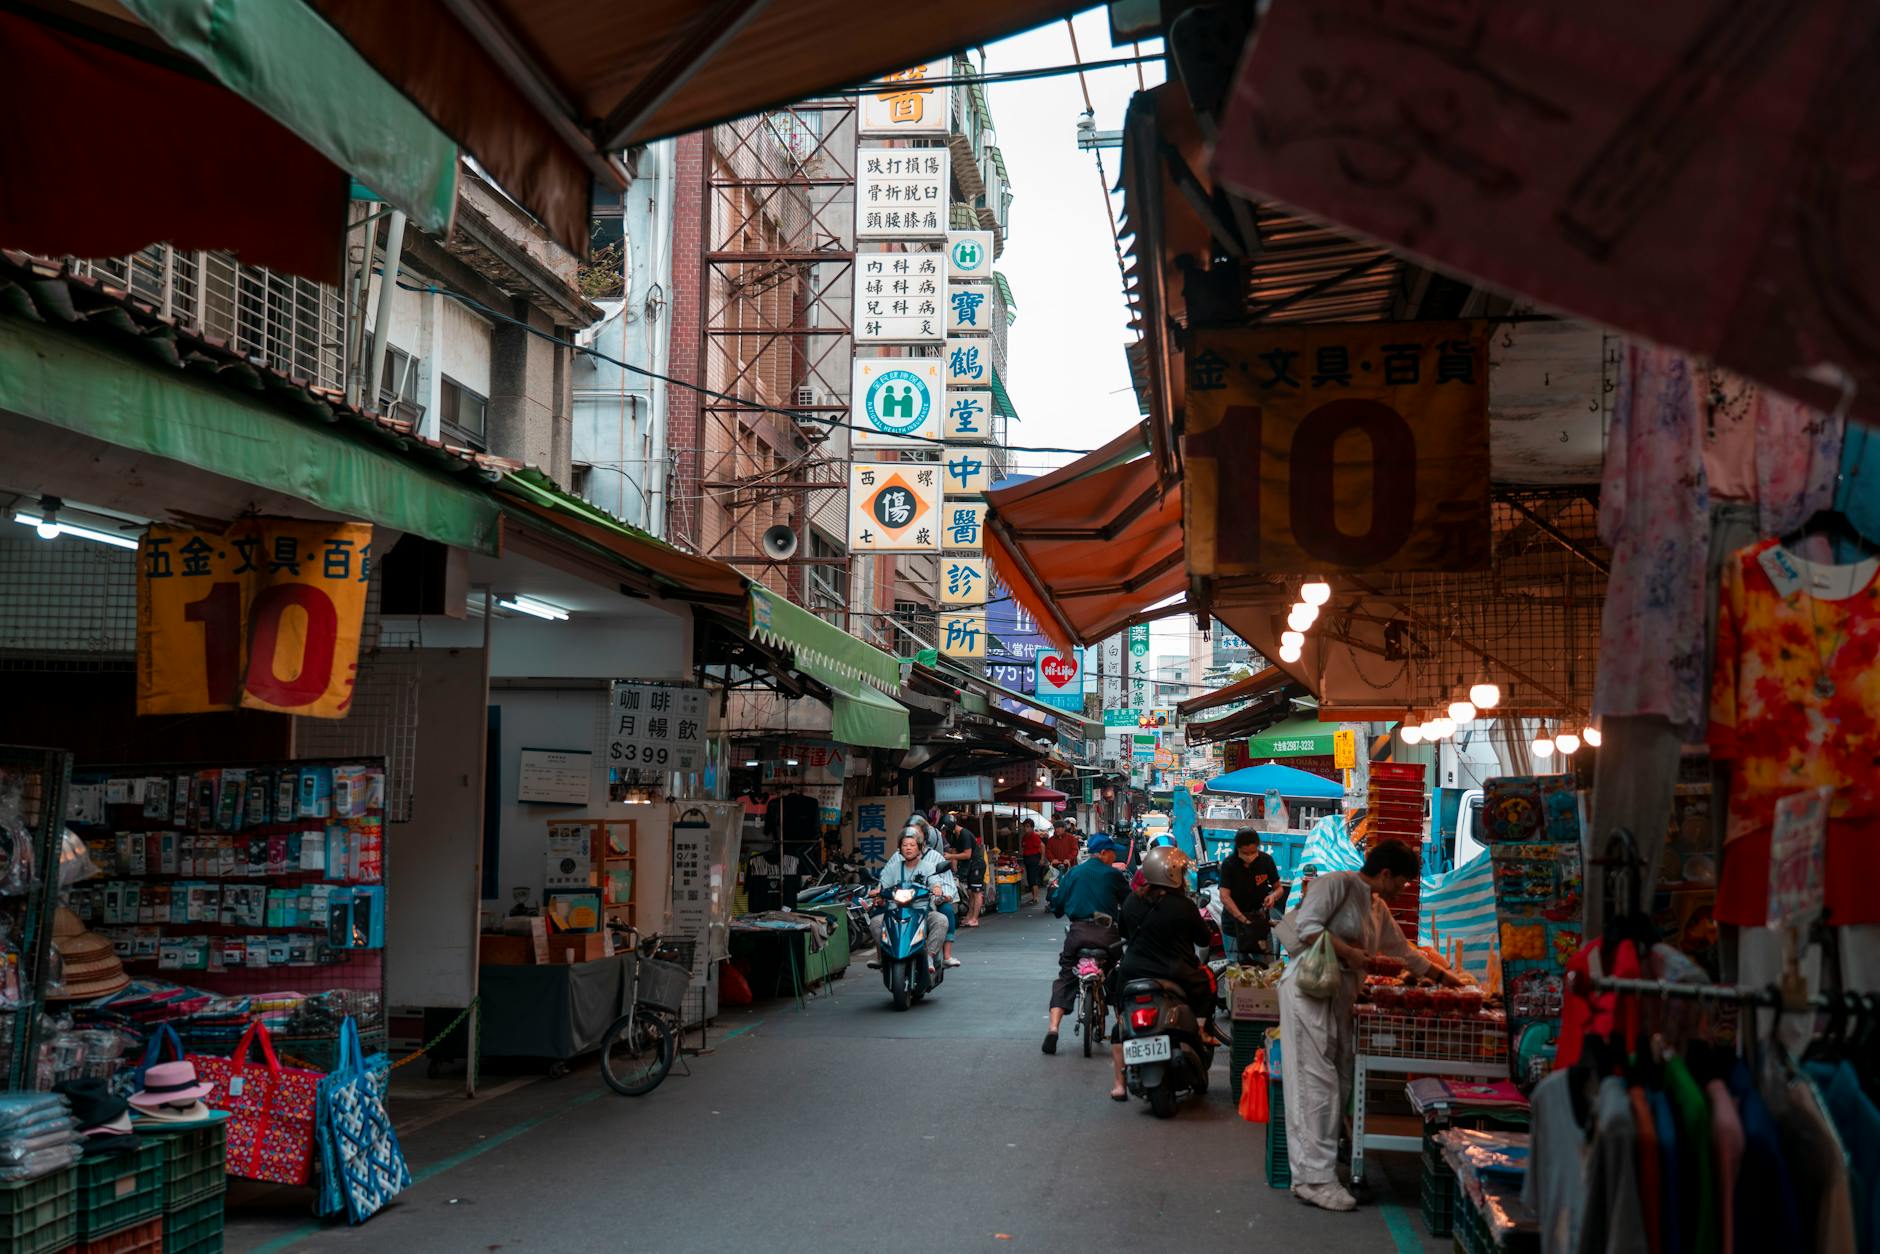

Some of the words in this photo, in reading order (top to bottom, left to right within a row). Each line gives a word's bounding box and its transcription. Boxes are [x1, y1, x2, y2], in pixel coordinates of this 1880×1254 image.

[867, 157, 940, 175] 跌打損傷
[866, 211, 938, 229] 頸腰膝痛
[865, 279, 936, 295] 婦科病
[866, 299, 936, 315] 兒科病
[867, 401, 884, 429] NATIONAL
[883, 425, 907, 433] HEALTH
[906, 403, 929, 431] INSURANCE
[882, 491, 911, 523] 傷
[1044, 662, 1075, 680] Hi-Life
[1132, 661, 1146, 713] 天佑藥
[619, 690, 671, 712] 咖啡
[610, 742, 668, 764] $399
[1125, 1041, 1167, 1059] MBE-5121
